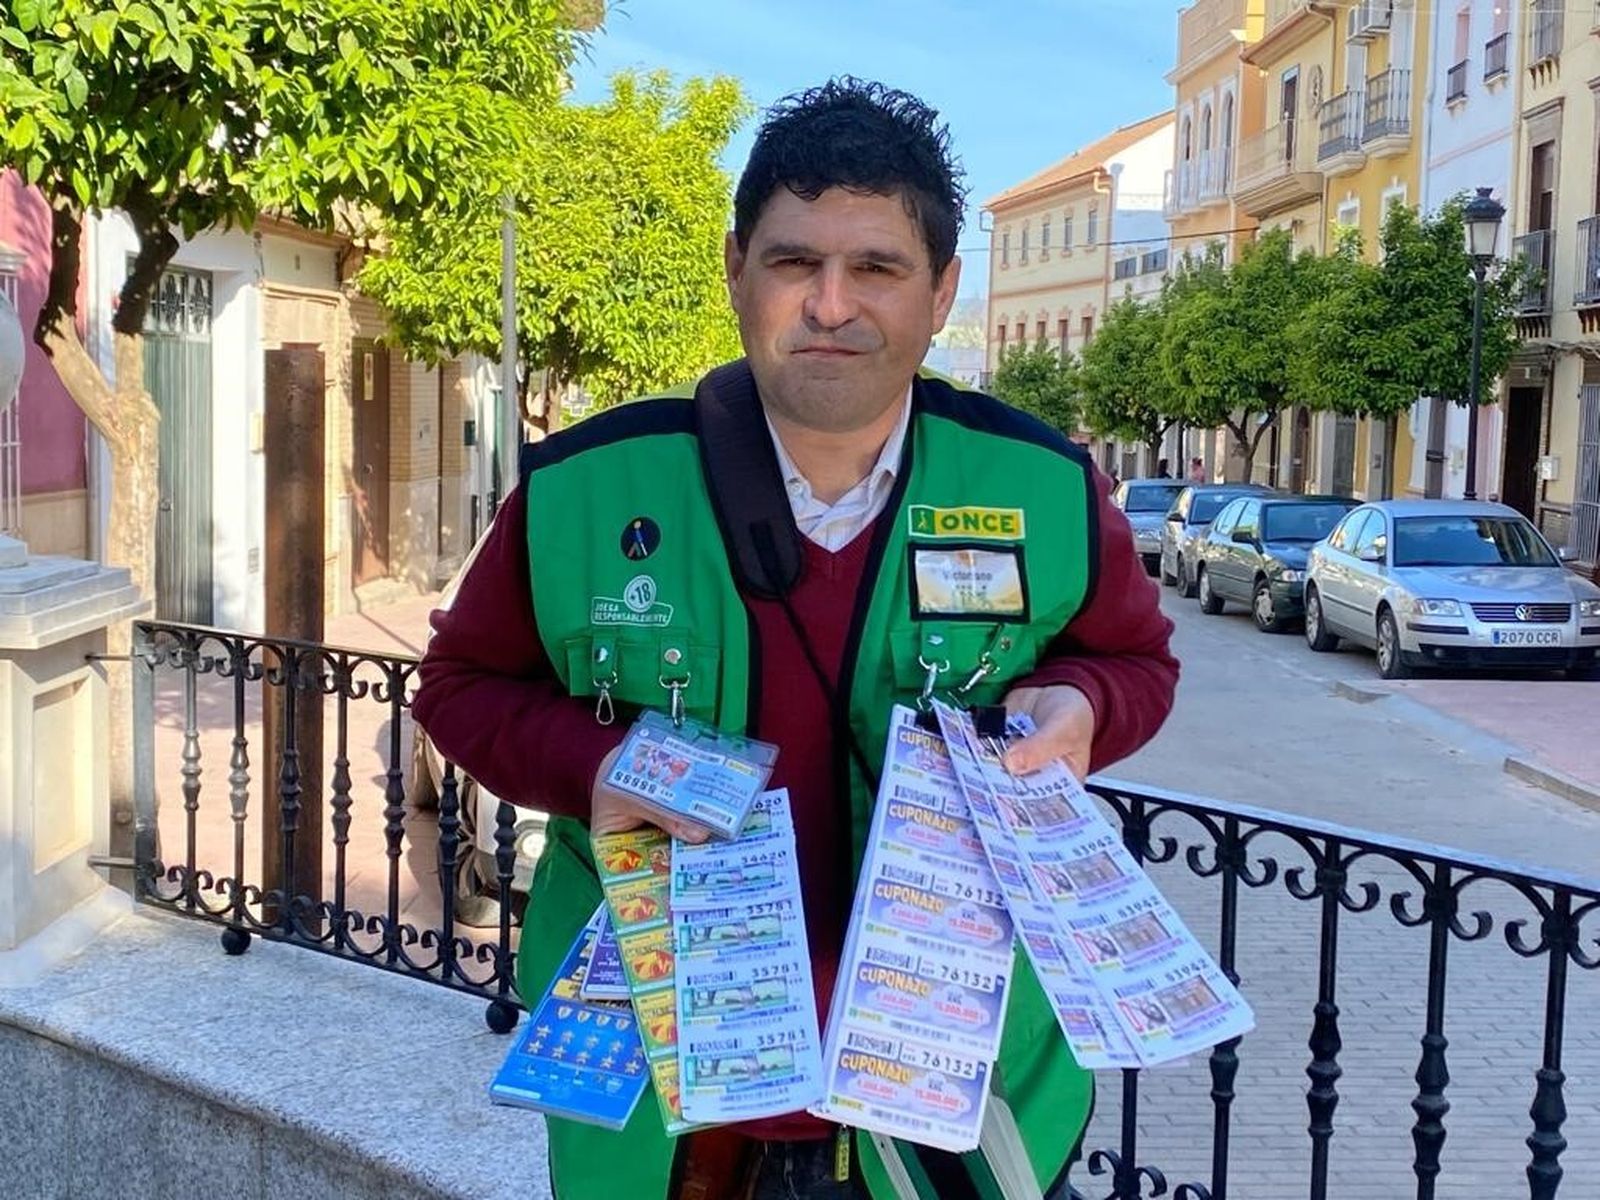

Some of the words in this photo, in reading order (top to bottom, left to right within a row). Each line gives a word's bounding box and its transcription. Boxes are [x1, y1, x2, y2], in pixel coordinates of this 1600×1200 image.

[940, 512, 1014, 534] ONCE
[630, 582, 651, 605] +18
[1501, 632, 1534, 644] 2070
[1536, 632, 1558, 644] CCR
[888, 804, 957, 833] CUPONAZO
[874, 884, 946, 917] CUPONAZO
[859, 966, 931, 998] CUPONAZO
[941, 965, 992, 990] 76132
[840, 1052, 913, 1087] CUPONAZO
[922, 1051, 974, 1077] 76132
